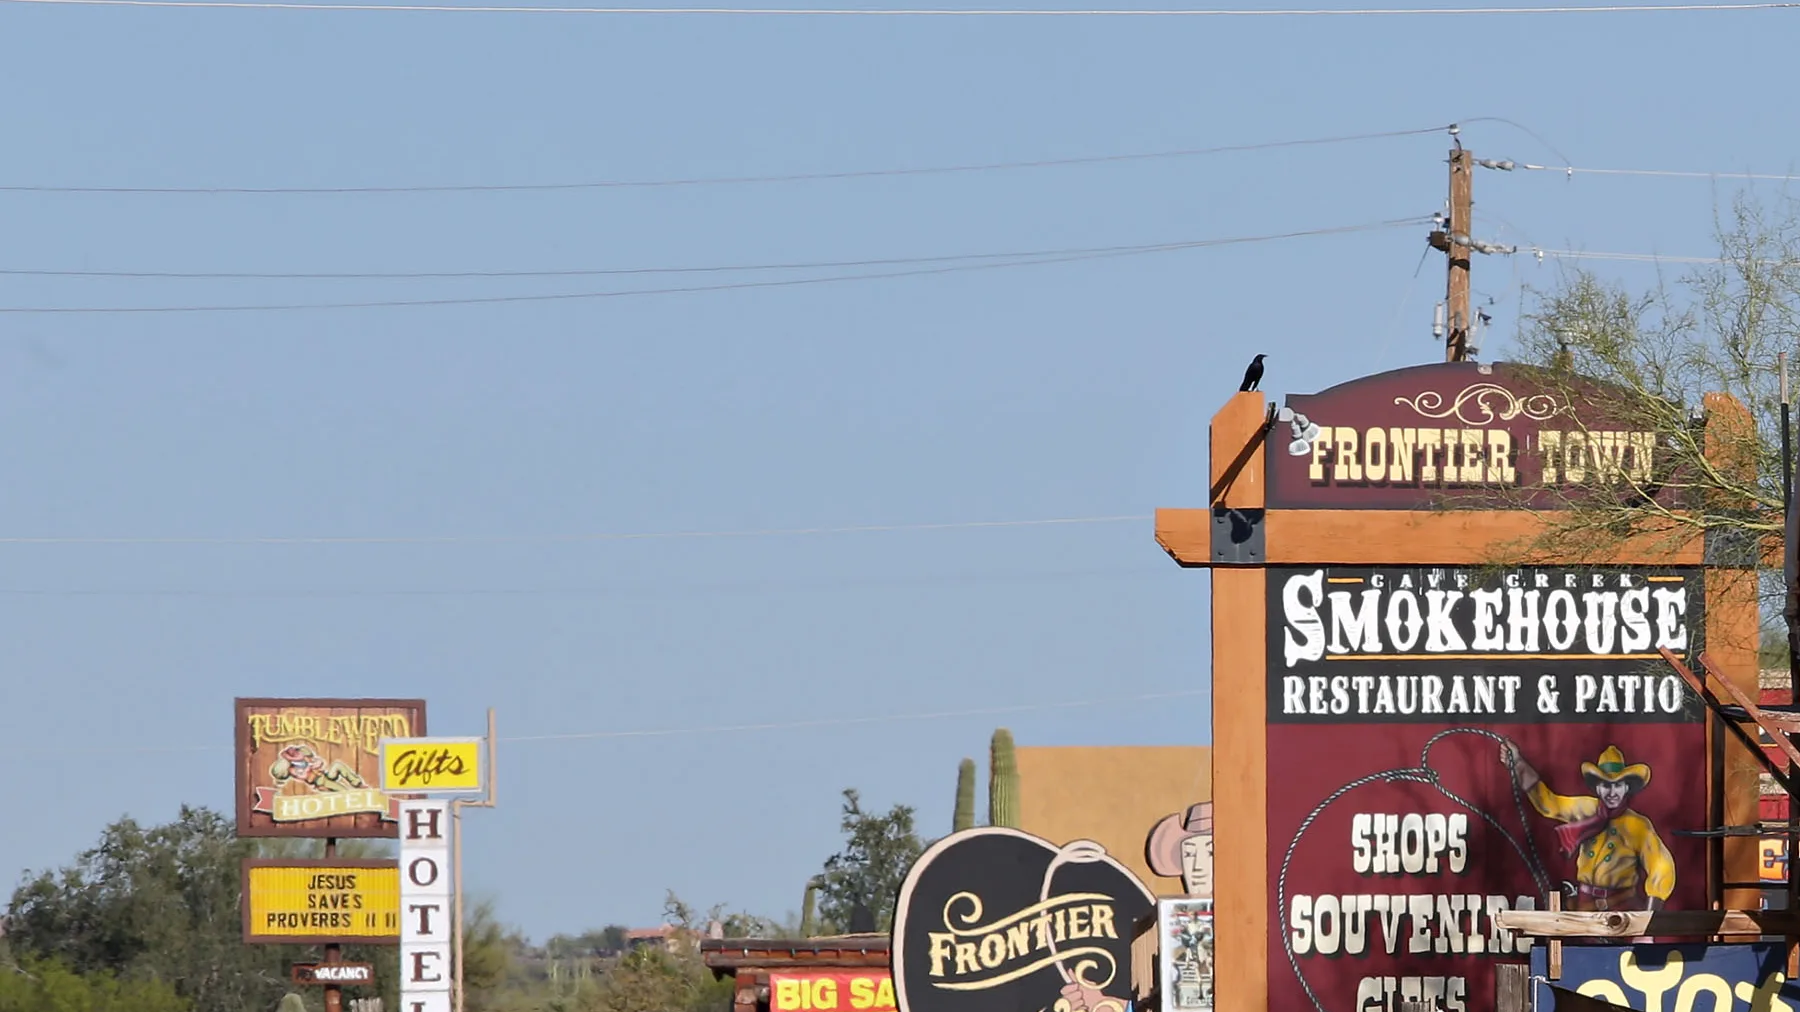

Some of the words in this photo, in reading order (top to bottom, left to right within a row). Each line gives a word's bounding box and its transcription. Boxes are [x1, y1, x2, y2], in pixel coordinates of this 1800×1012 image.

[1308, 426, 1516, 484] FRONTIER
[1537, 430, 1656, 484] TOWN
[1371, 574, 1469, 588] CAVE
[1506, 574, 1632, 588] CREEK
[1282, 569, 1687, 668] SMOKEHOUSE
[1282, 674, 1522, 716] RESTAURANT
[1536, 675, 1561, 714] &
[1575, 674, 1684, 716] PATIO
[393, 749, 470, 785] Gifts
[281, 791, 383, 817] HOTEL
[1352, 813, 1468, 874] SHOPS
[308, 875, 356, 889] JESUS
[308, 894, 362, 909] SAVES
[267, 912, 351, 928] PROVERBS
[928, 904, 1118, 976] FRONTIER
[315, 967, 369, 980] VACANCY
[776, 978, 837, 1010] BIG
[850, 978, 896, 1009] SA
